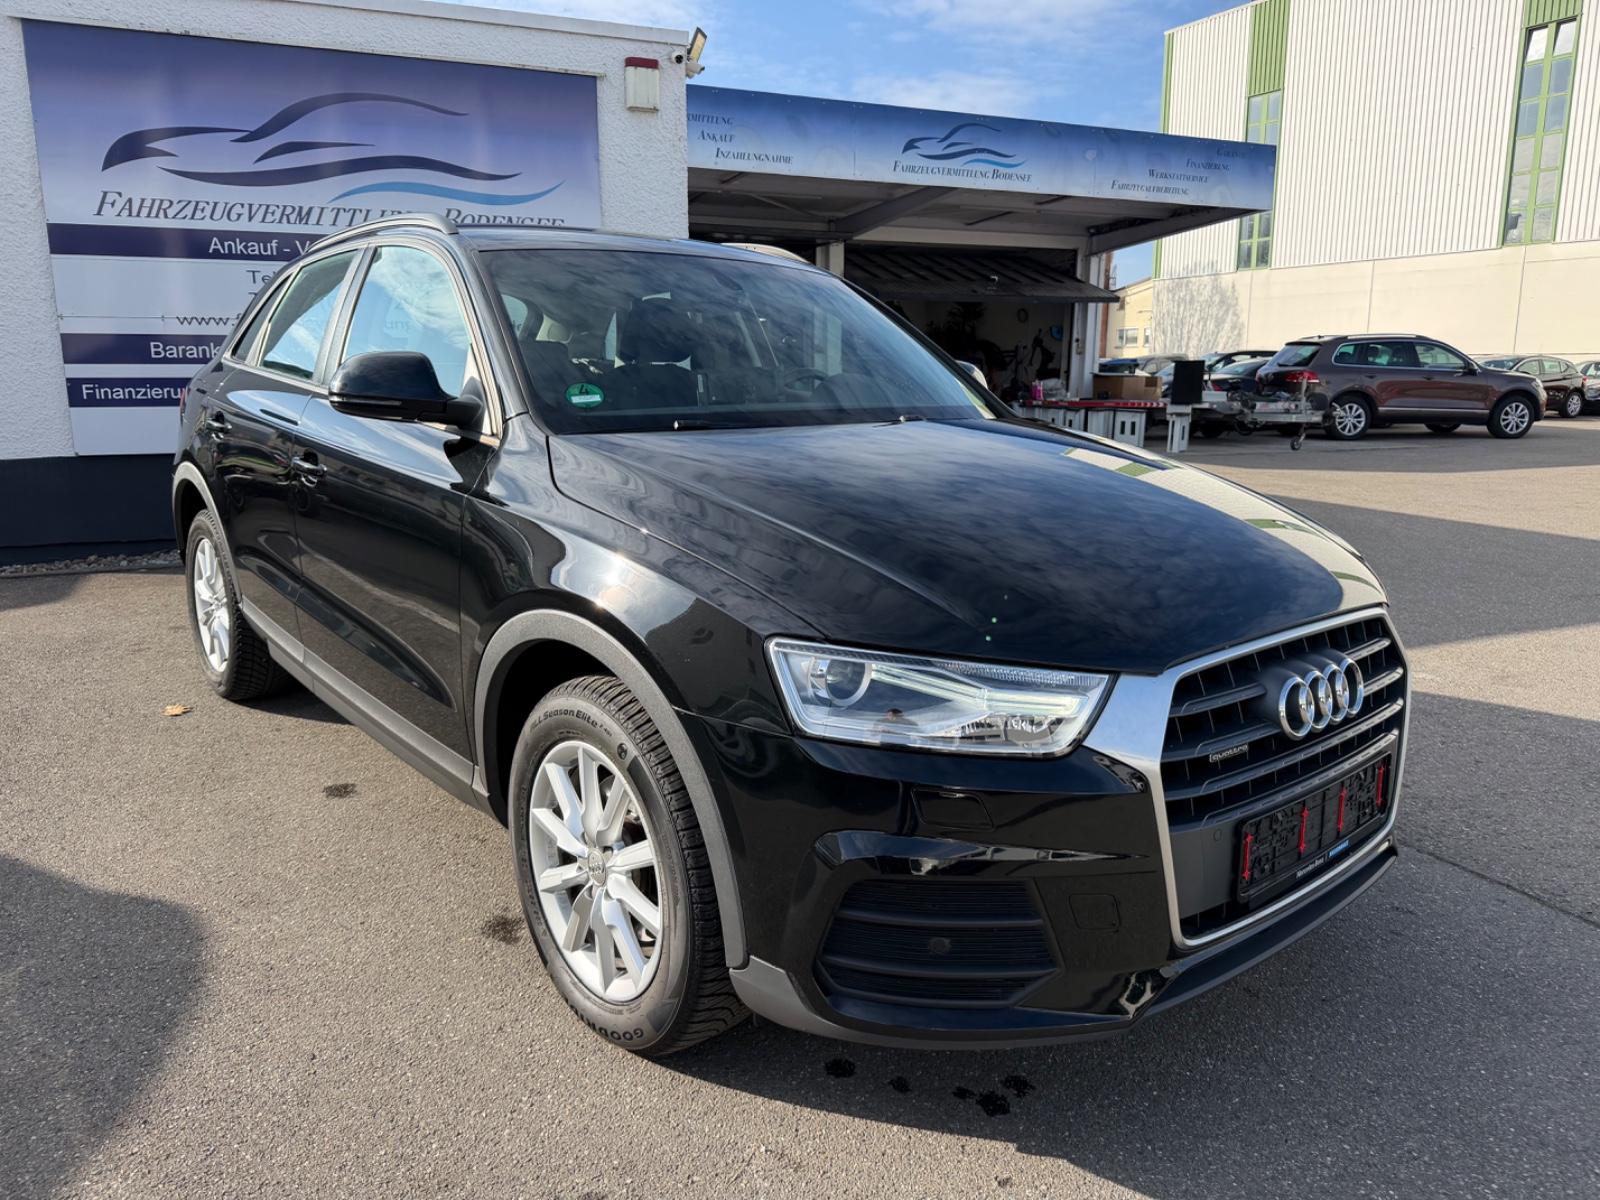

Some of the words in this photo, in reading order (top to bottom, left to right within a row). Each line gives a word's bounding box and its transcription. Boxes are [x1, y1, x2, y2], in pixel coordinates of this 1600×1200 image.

[687, 112, 734, 125] MITTLUNG
[93, 190, 415, 227] FAHRZEUGVERMITTL
[208, 237, 279, 256] Ankauf
[295, 240, 310, 256] V
[246, 269, 276, 285] Te
[150, 342, 221, 358] Barank
[579, 384, 589, 396] 4
[543, 709, 575, 720] Season
[575, 710, 598, 728] Elite
[1209, 744, 1248, 763] quattro
